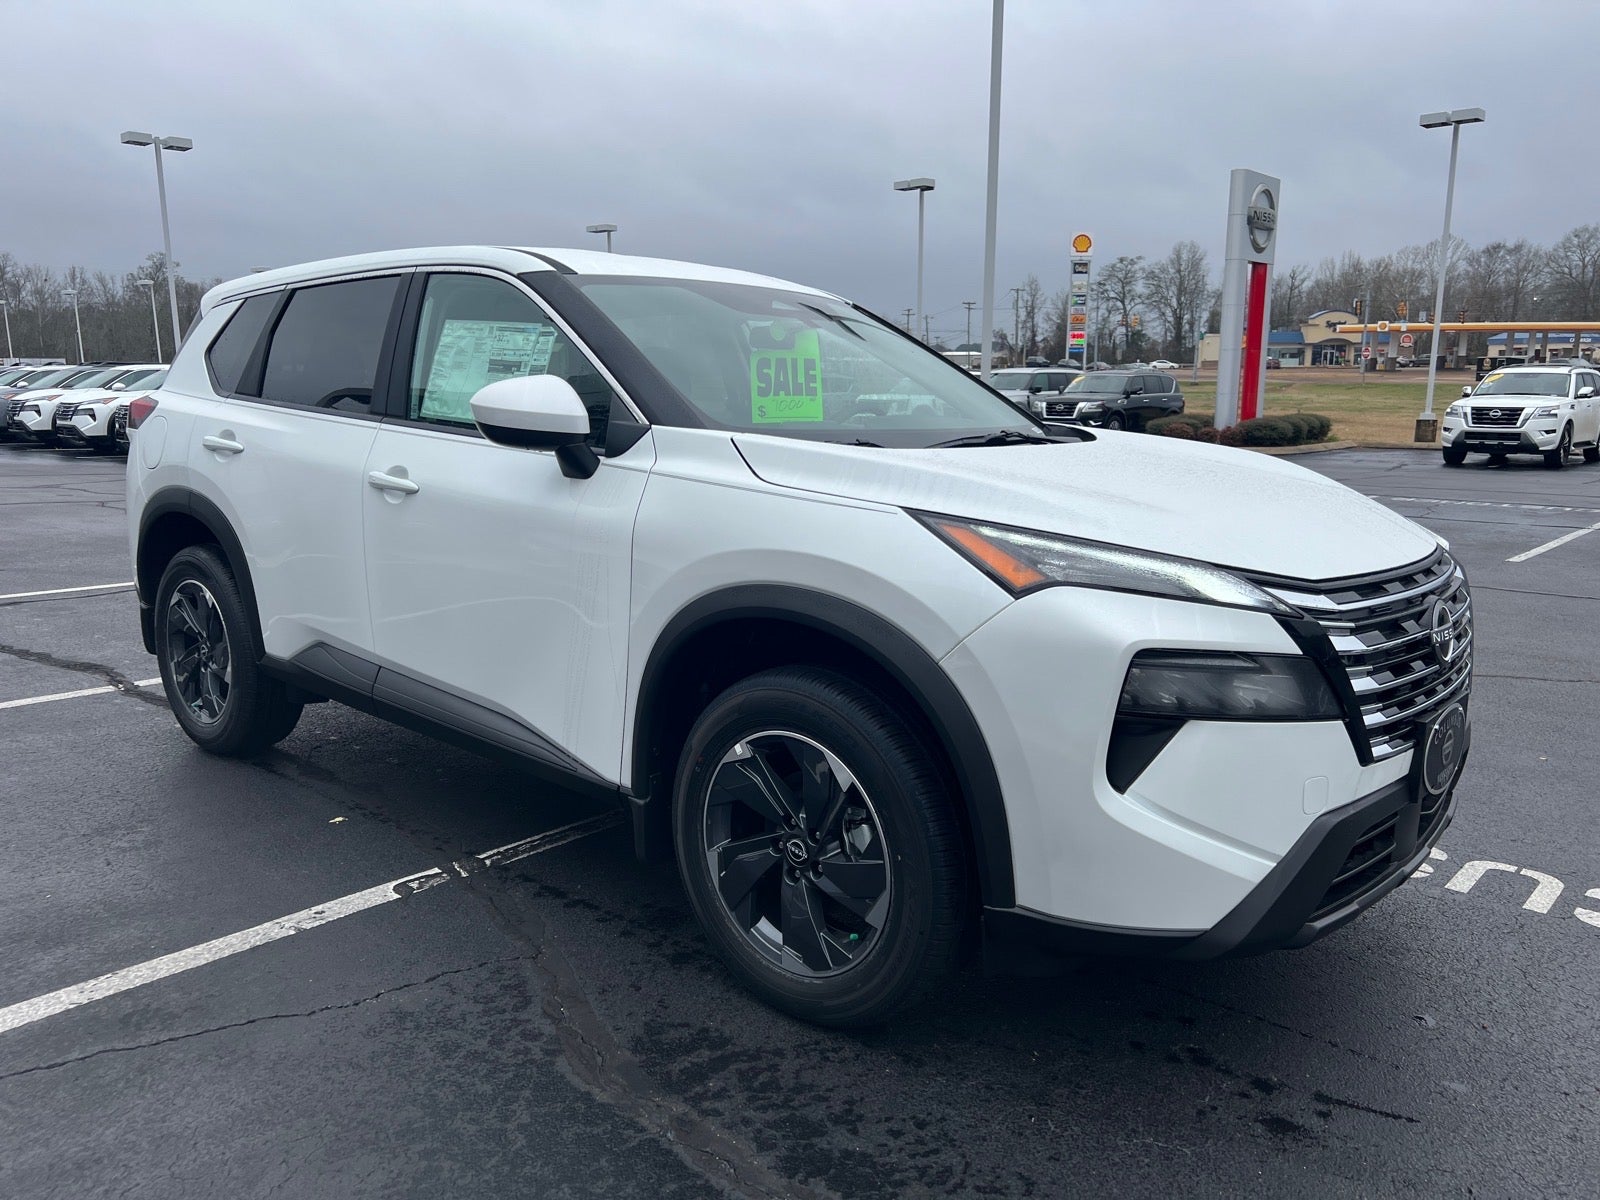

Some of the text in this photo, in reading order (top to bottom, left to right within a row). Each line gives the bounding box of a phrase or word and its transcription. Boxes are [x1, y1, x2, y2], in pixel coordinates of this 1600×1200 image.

[1252, 209, 1274, 223] NISS
[756, 357, 818, 397] SALE
[757, 405, 766, 418] $
[1432, 629, 1453, 643] NISS
